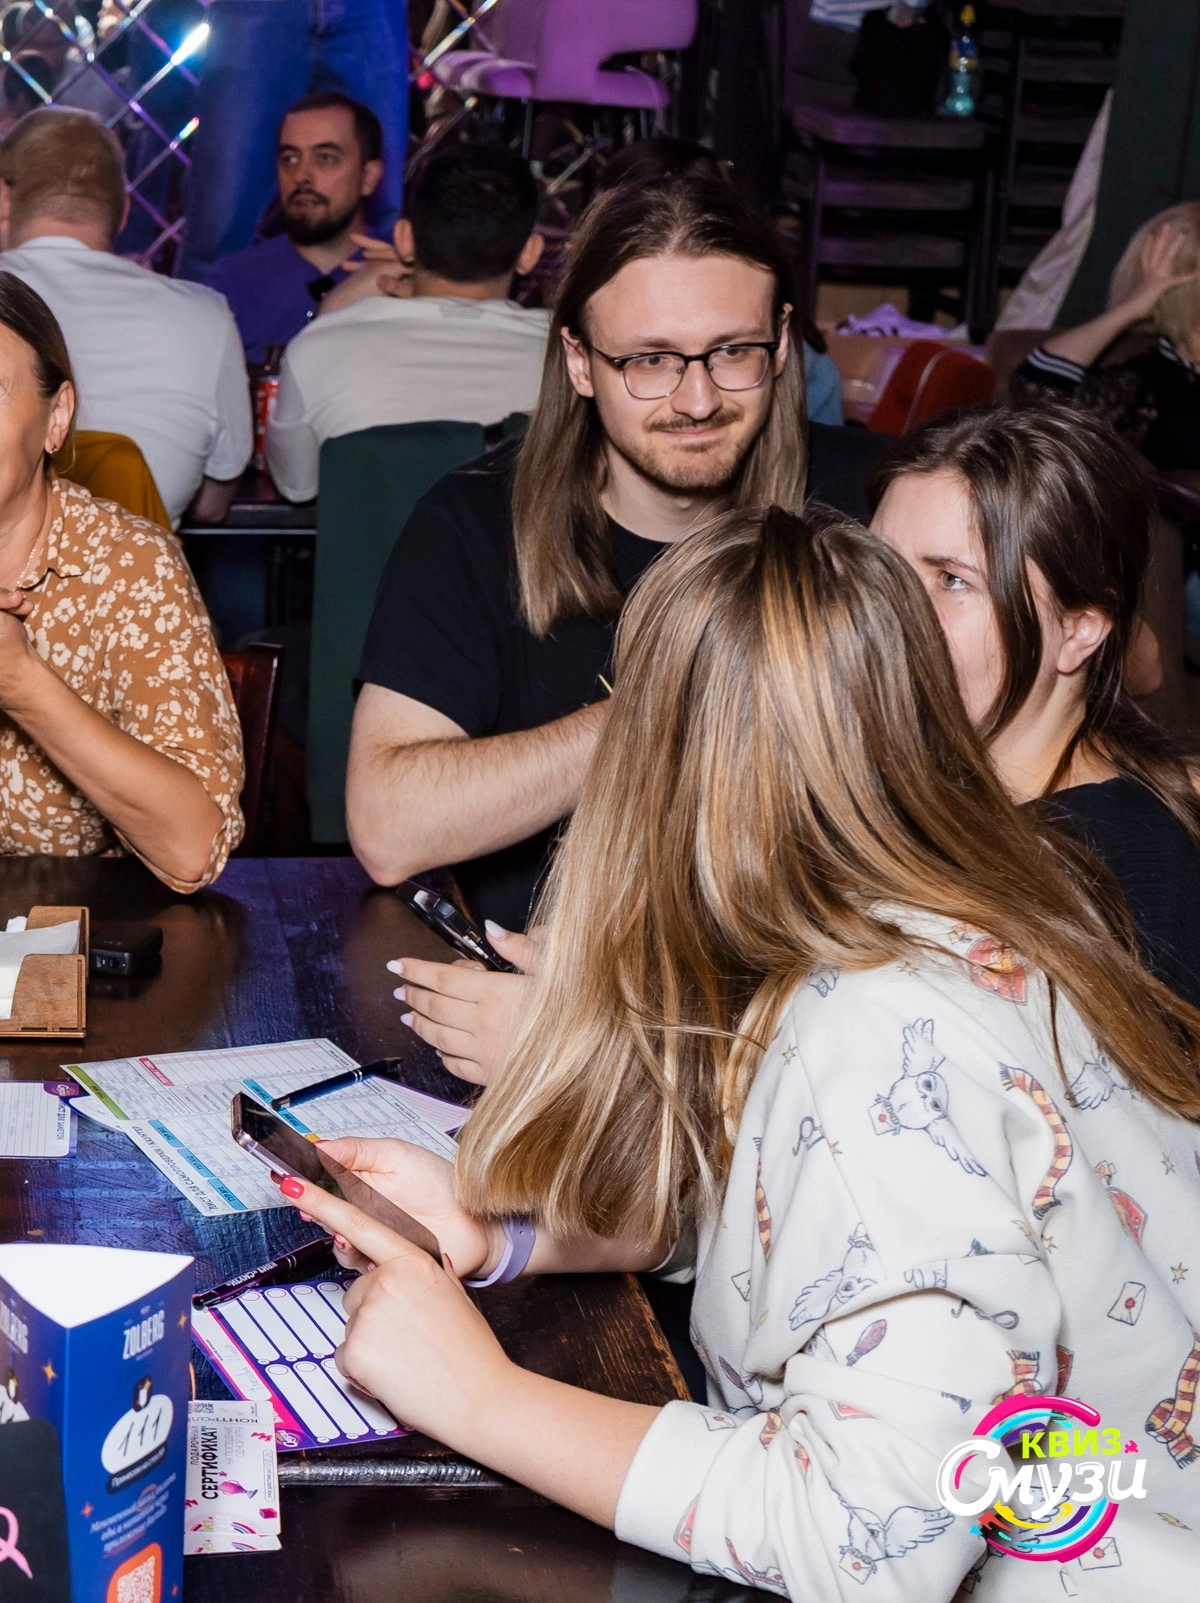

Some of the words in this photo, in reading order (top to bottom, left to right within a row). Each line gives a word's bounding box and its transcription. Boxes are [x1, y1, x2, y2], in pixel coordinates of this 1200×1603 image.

[122, 1309, 165, 1360] ZOLBERG
[188, 1416, 258, 1424] КОНТРОЛ
[201, 1426, 219, 1500] СЕРТИФИКАТ
